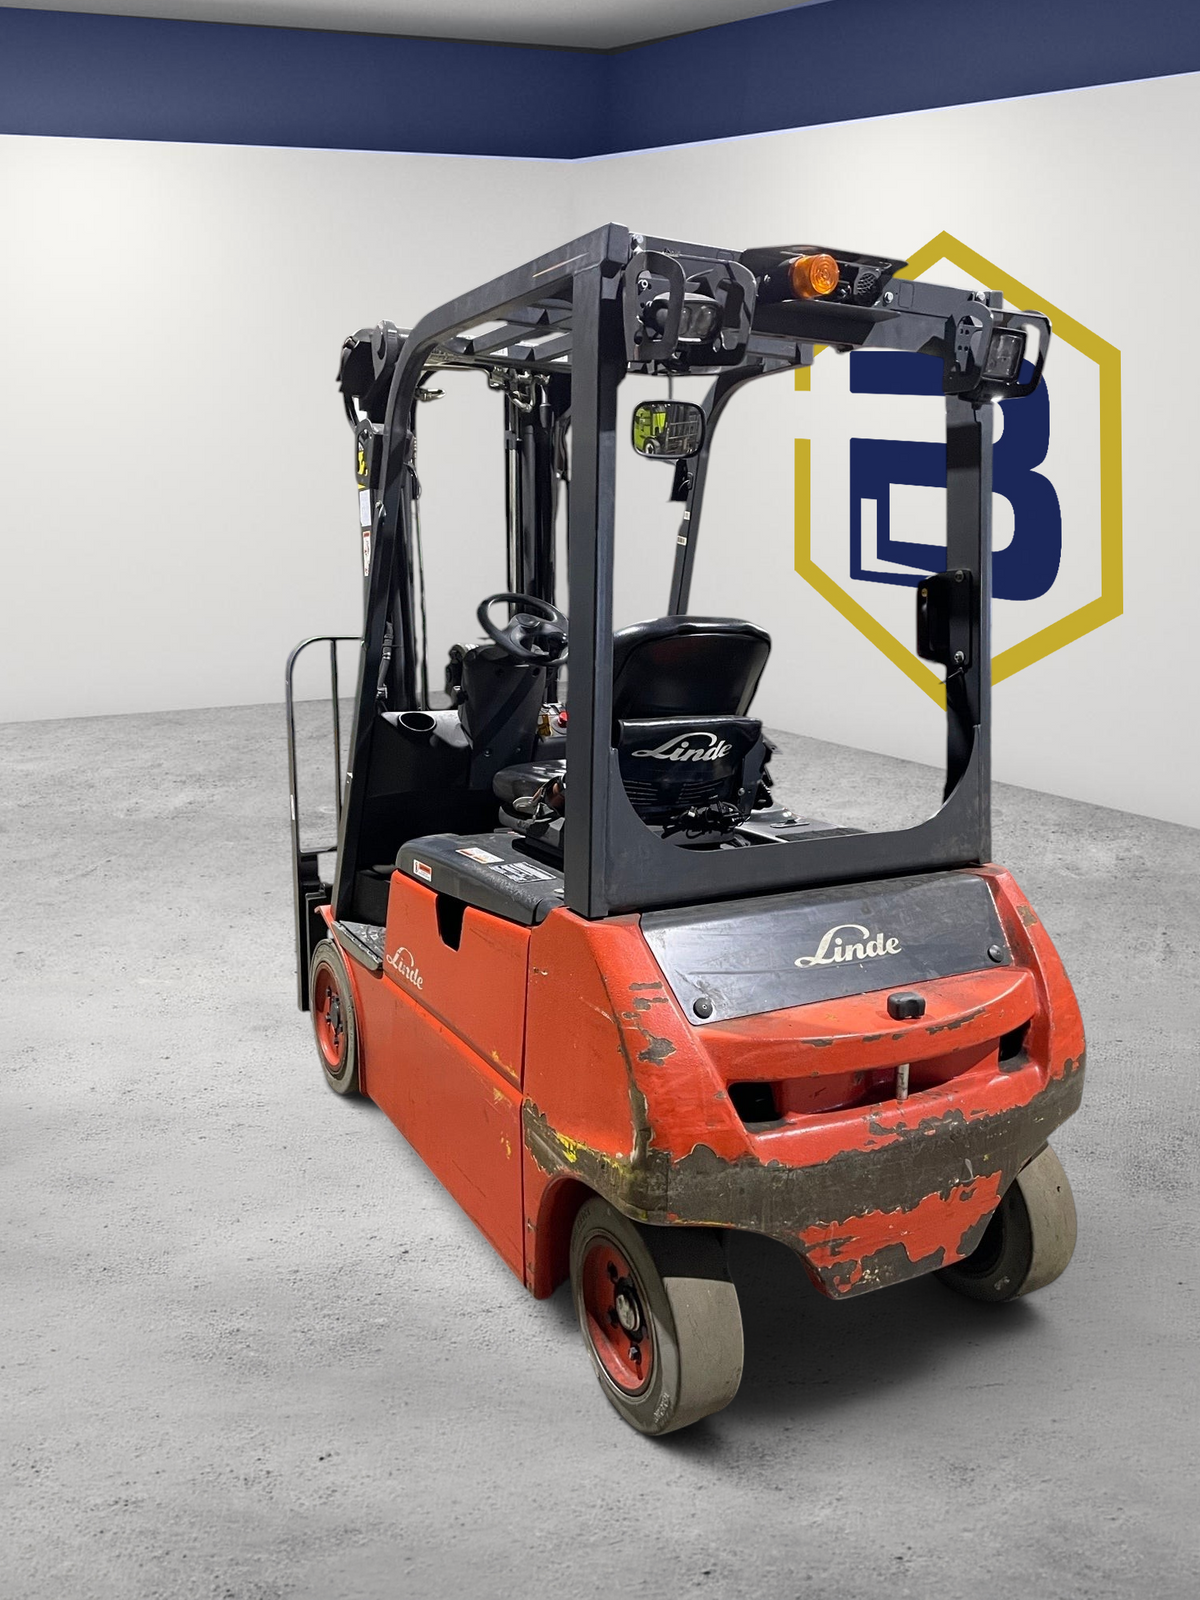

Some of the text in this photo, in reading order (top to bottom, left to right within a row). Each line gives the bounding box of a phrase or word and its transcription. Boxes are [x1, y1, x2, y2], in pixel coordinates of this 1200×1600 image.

[631, 731, 733, 762] Linde
[386, 946, 423, 990] Linde
[794, 924, 902, 968] Linde
